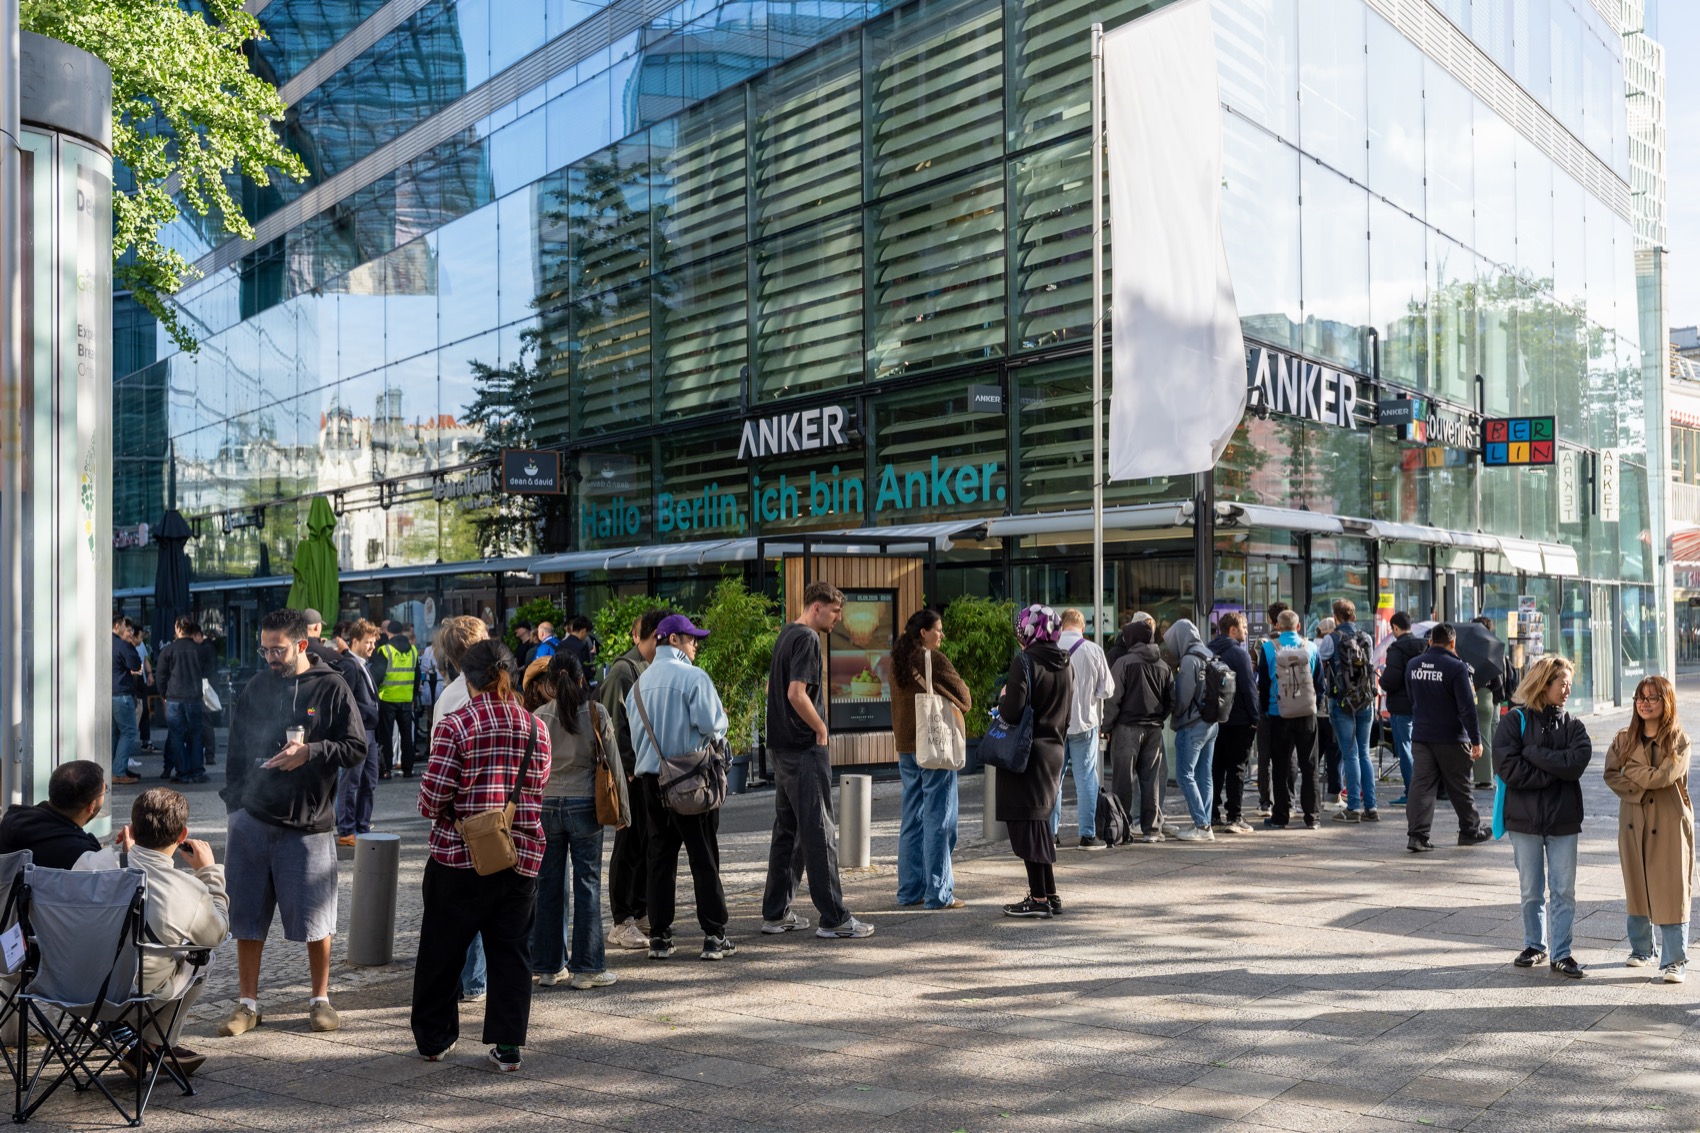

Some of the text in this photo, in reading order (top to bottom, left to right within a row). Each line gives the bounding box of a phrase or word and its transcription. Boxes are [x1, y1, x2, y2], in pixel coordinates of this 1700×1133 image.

[1250, 348, 1357, 430] ANKER
[975, 394, 1000, 403] ANKER
[1380, 407, 1409, 417] ANKER
[737, 405, 844, 460] ANKER
[509, 477, 553, 486] dean & david
[1603, 450, 1613, 519] ARKET
[582, 455, 1006, 540] Hallo Berlin, ich bin Anker.
[1421, 661, 1435, 669] Team
[1411, 667, 1443, 682] KÖTTER
